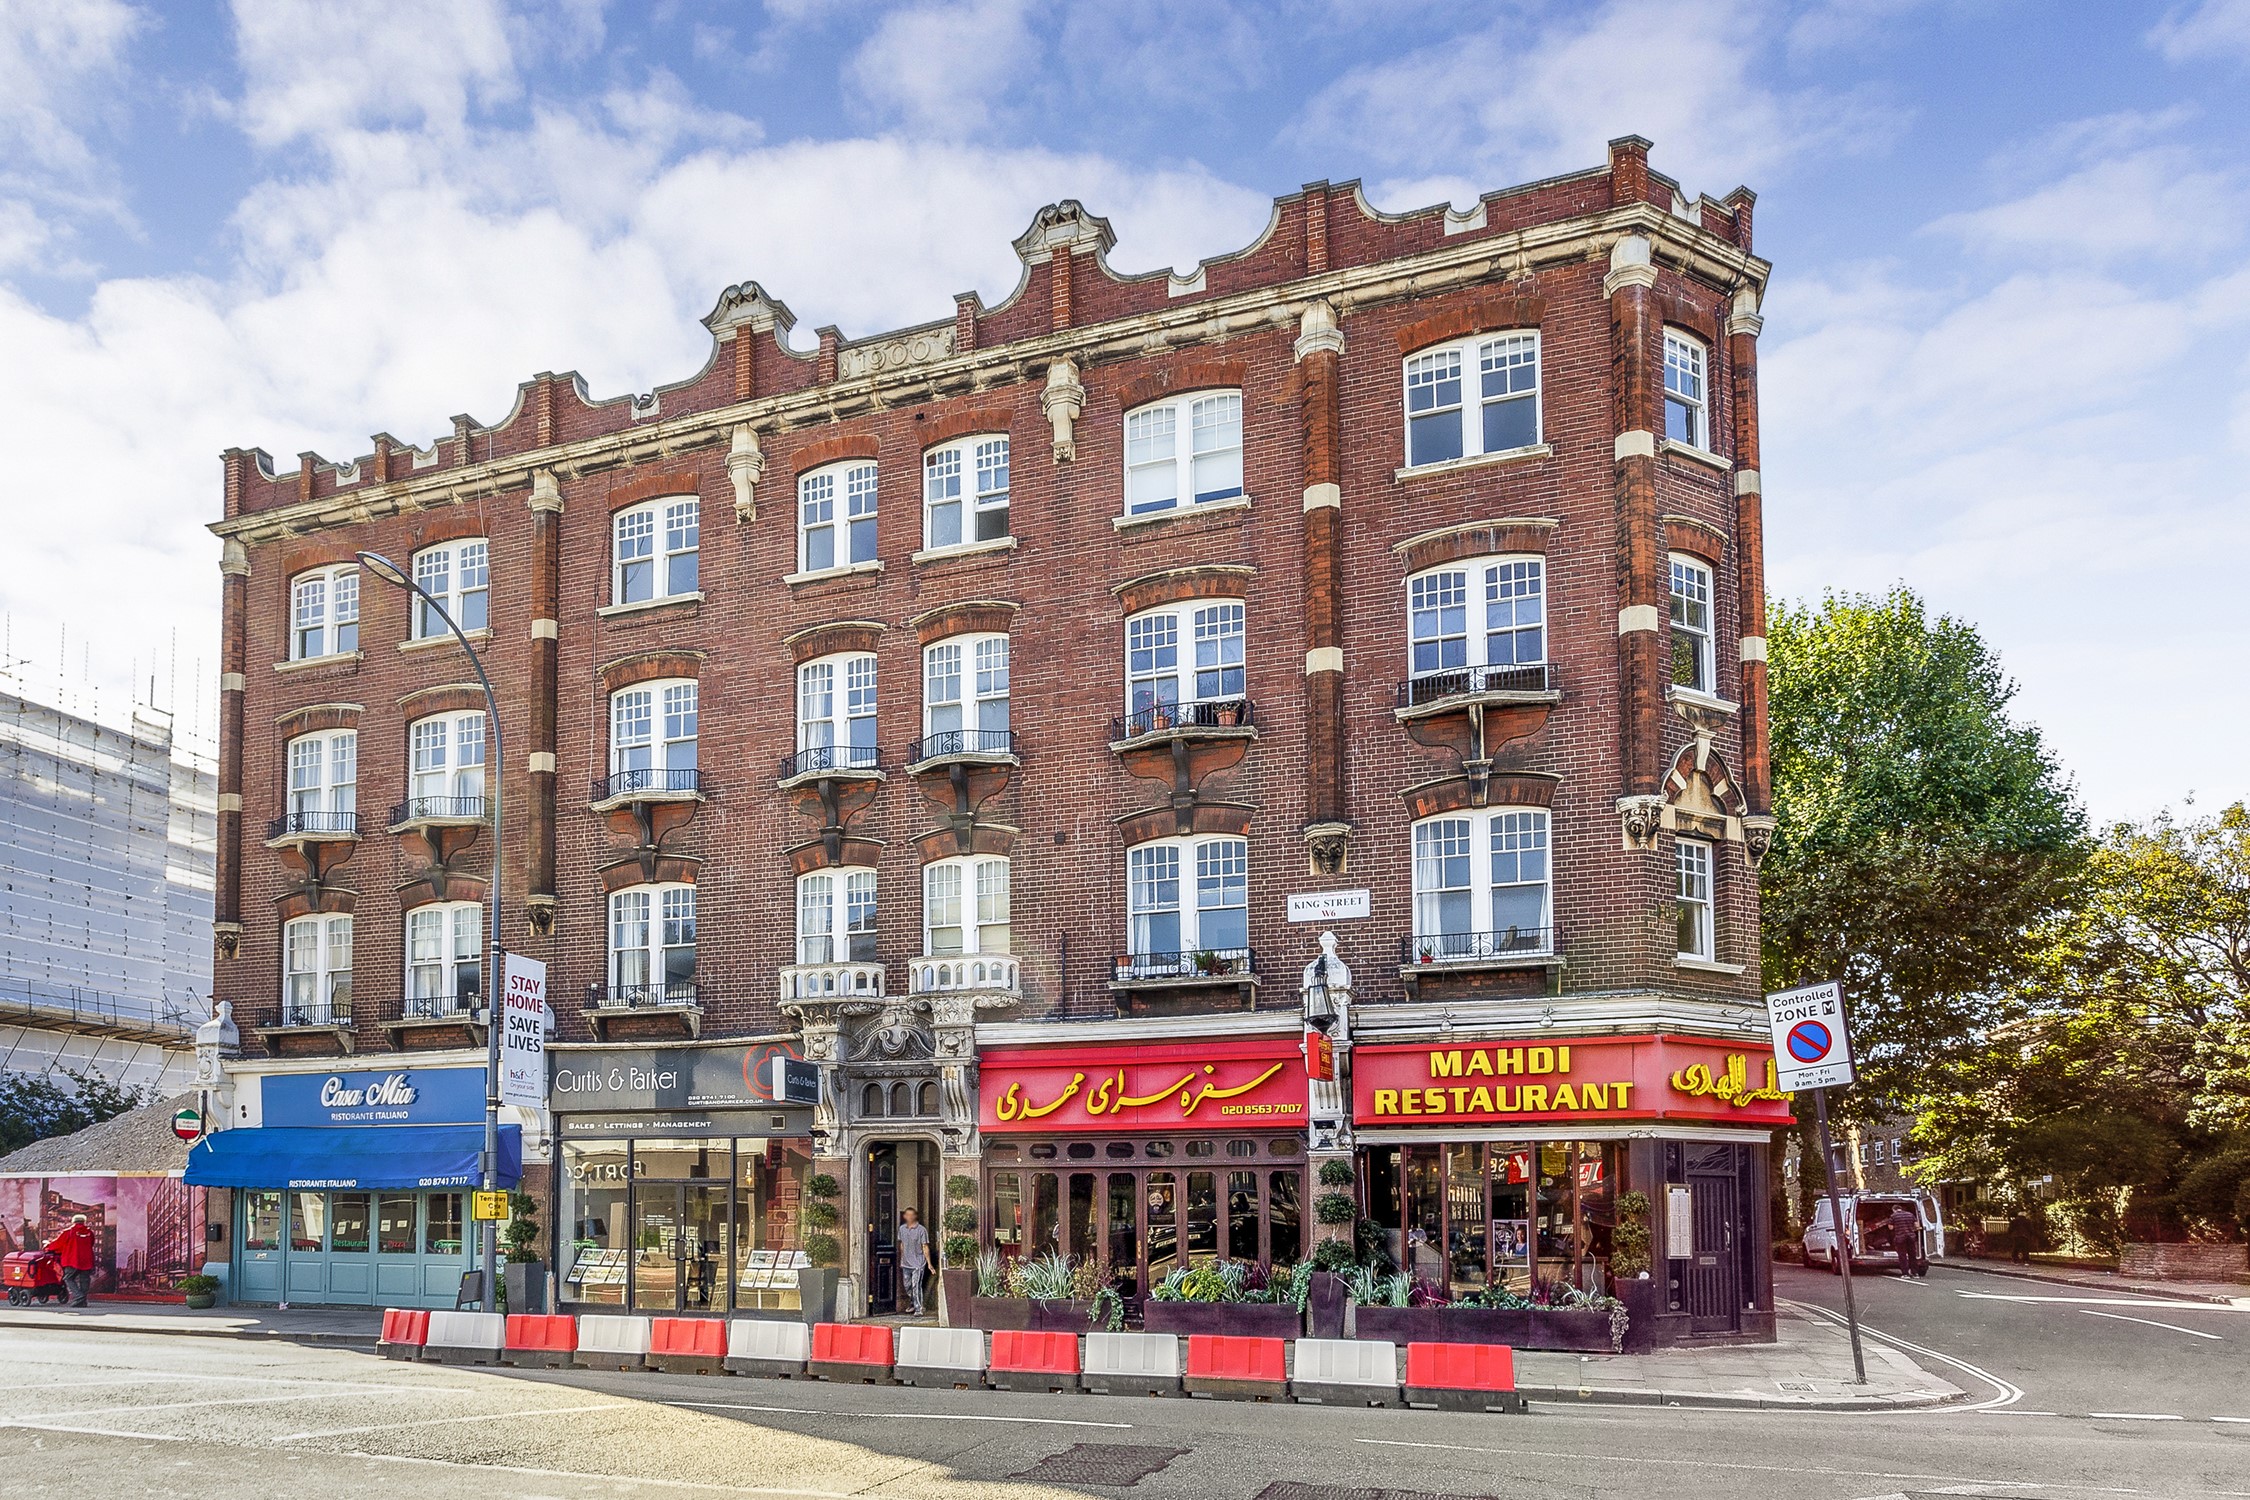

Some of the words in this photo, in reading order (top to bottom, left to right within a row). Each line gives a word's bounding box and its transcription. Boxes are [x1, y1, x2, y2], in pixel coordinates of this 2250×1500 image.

[858, 340, 930, 372] 1900
[1294, 900, 1320, 910] KING
[1323, 897, 1363, 908] STREET
[1321, 909, 1336, 917] W6
[511, 975, 540, 994] STAY
[506, 992, 543, 1014] HOME
[1773, 988, 1834, 1008] Controlled
[1775, 1005, 1818, 1023] ZONE
[1822, 1001, 1835, 1015] M
[509, 1015, 540, 1035] SAVE
[508, 1033, 541, 1053] LIVES
[1430, 1046, 1571, 1078] MAHDI
[510, 1069, 524, 1080] h&f
[555, 1069, 603, 1093] Curtis
[608, 1068, 624, 1091] &
[630, 1067, 678, 1090] Parker
[1798, 1071, 1814, 1079] Mon
[1824, 1076, 1836, 1085] pm
[320, 1076, 364, 1107] Casa
[365, 1074, 419, 1107] Mia
[1374, 1081, 1634, 1115] RESTAURANT
[1221, 1105, 1243, 1115] 020
[1244, 1104, 1272, 1114] 8563
[1274, 1103, 1303, 1113] 7007
[331, 1112, 374, 1121] RISTORANTE
[375, 1111, 408, 1120] ITALIANO
[568, 1122, 595, 1130] SALES
[604, 1121, 643, 1129] LETTINGS
[652, 1120, 712, 1128] MANAGEMENT
[288, 1180, 327, 1188] RISTORANTE
[327, 1179, 357, 1187] ITALIANO
[419, 1178, 432, 1187] 020
[432, 1177, 449, 1186] 8741
[450, 1176, 468, 1185] 7117
[333, 1239, 369, 1247] Restaurant
[387, 1240, 406, 1249] Pizza
